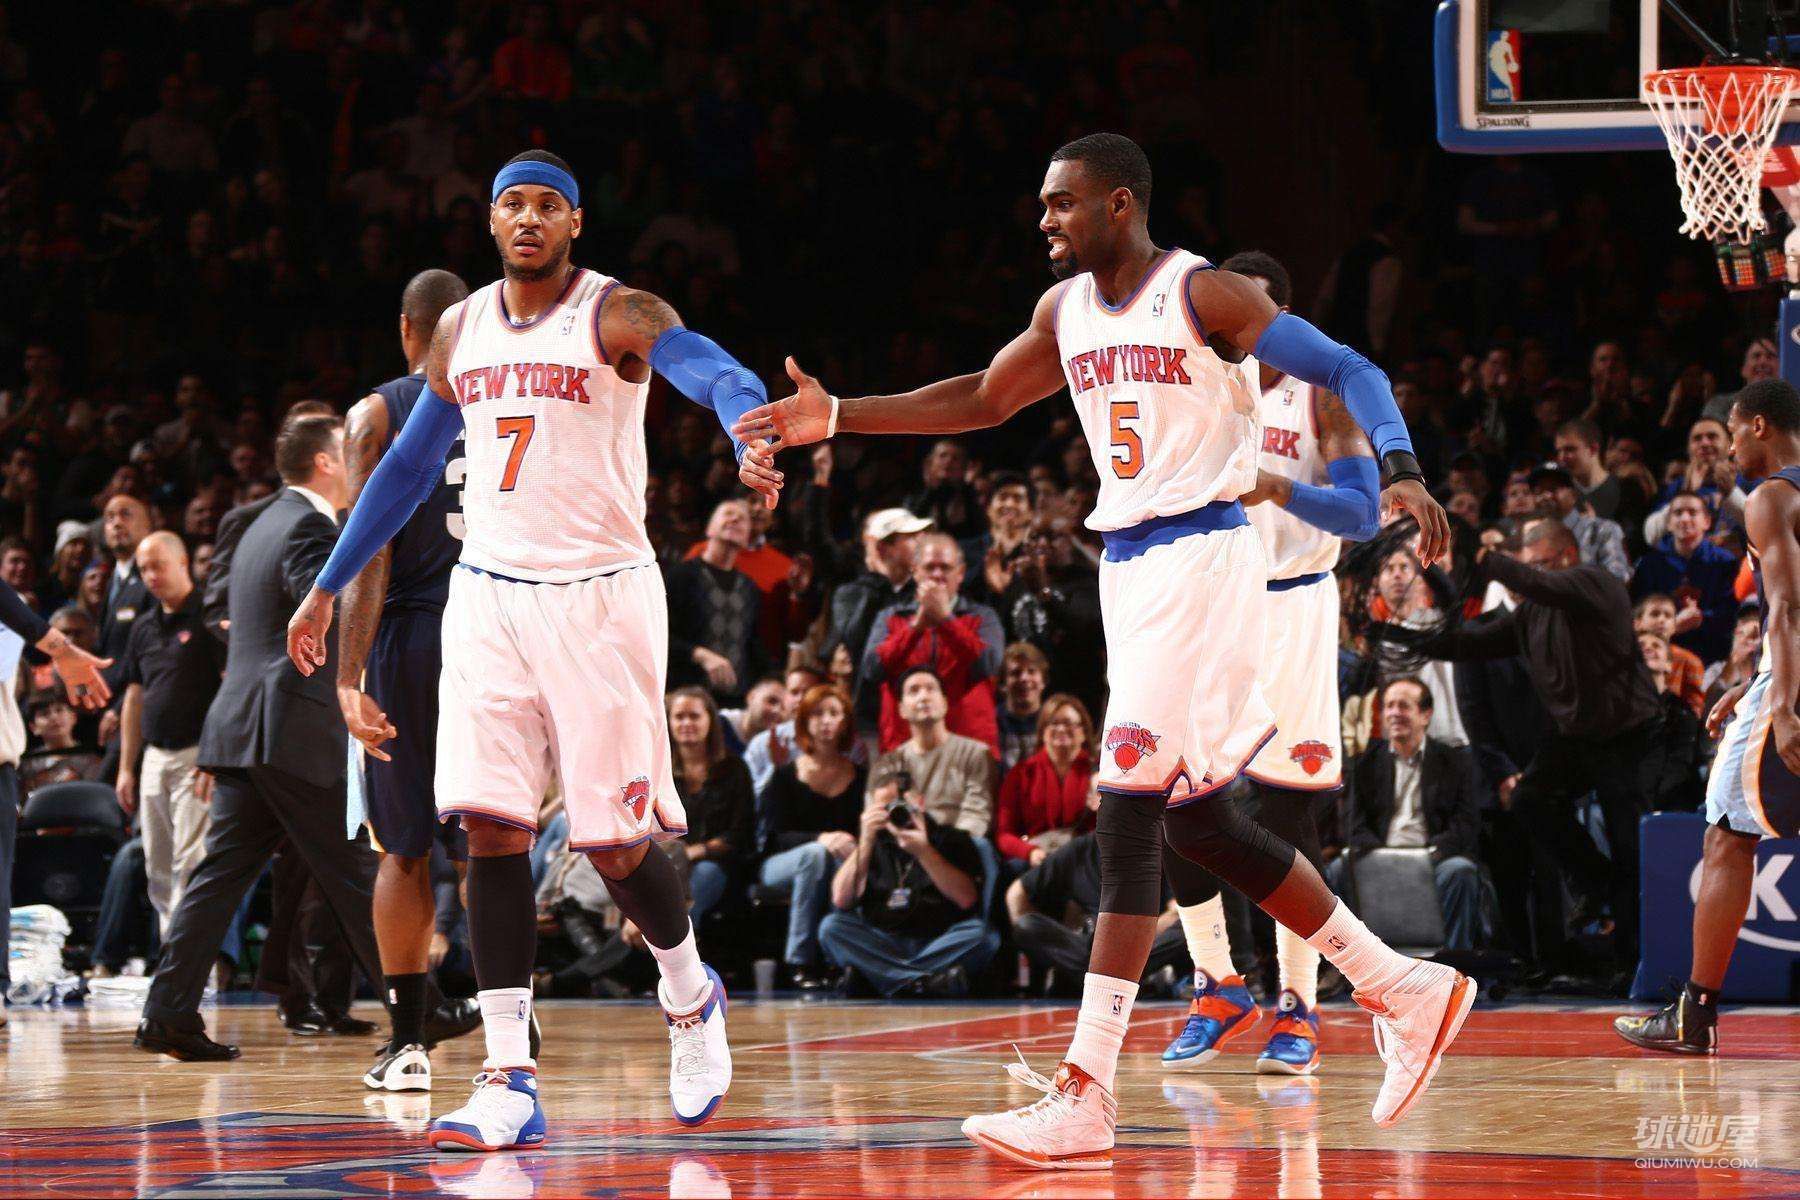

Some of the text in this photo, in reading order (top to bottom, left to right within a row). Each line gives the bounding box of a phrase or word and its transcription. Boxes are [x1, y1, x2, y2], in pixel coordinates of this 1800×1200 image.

[1477, 116, 1530, 128] SPALDING
[454, 362, 590, 407] NEW YORK
[1067, 344, 1192, 395] NEW YORK
[496, 415, 535, 492] 7
[1110, 401, 1145, 479] 5
[1261, 426, 1300, 460] RK
